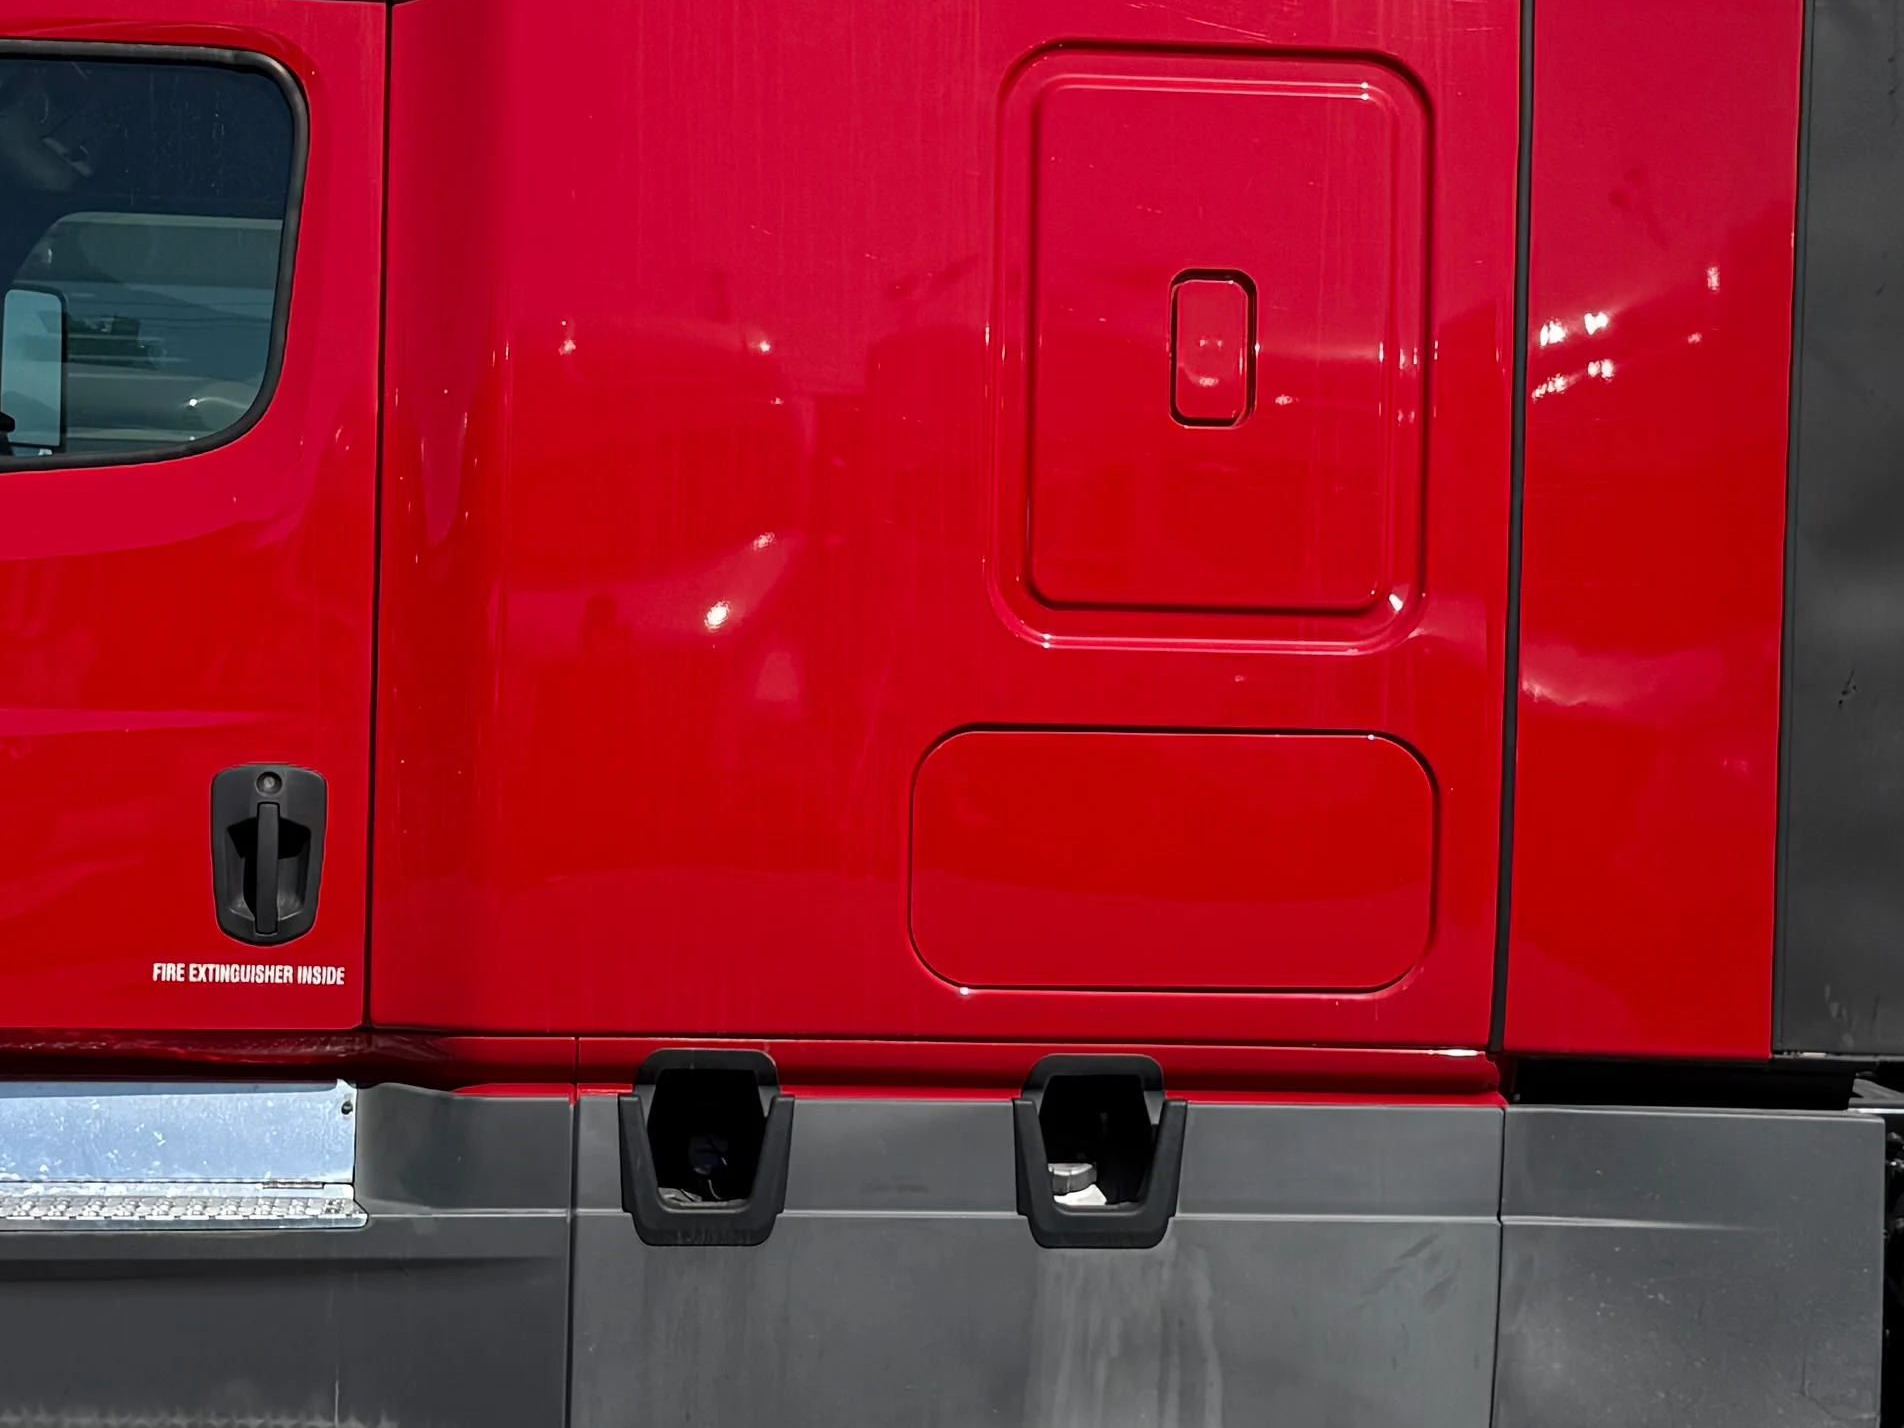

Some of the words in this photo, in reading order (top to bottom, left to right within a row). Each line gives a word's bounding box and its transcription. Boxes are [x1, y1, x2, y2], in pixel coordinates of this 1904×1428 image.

[152, 962, 186, 983] FIRE
[188, 963, 293, 984] EXTINGUISHER
[297, 965, 346, 985] INSIDE
